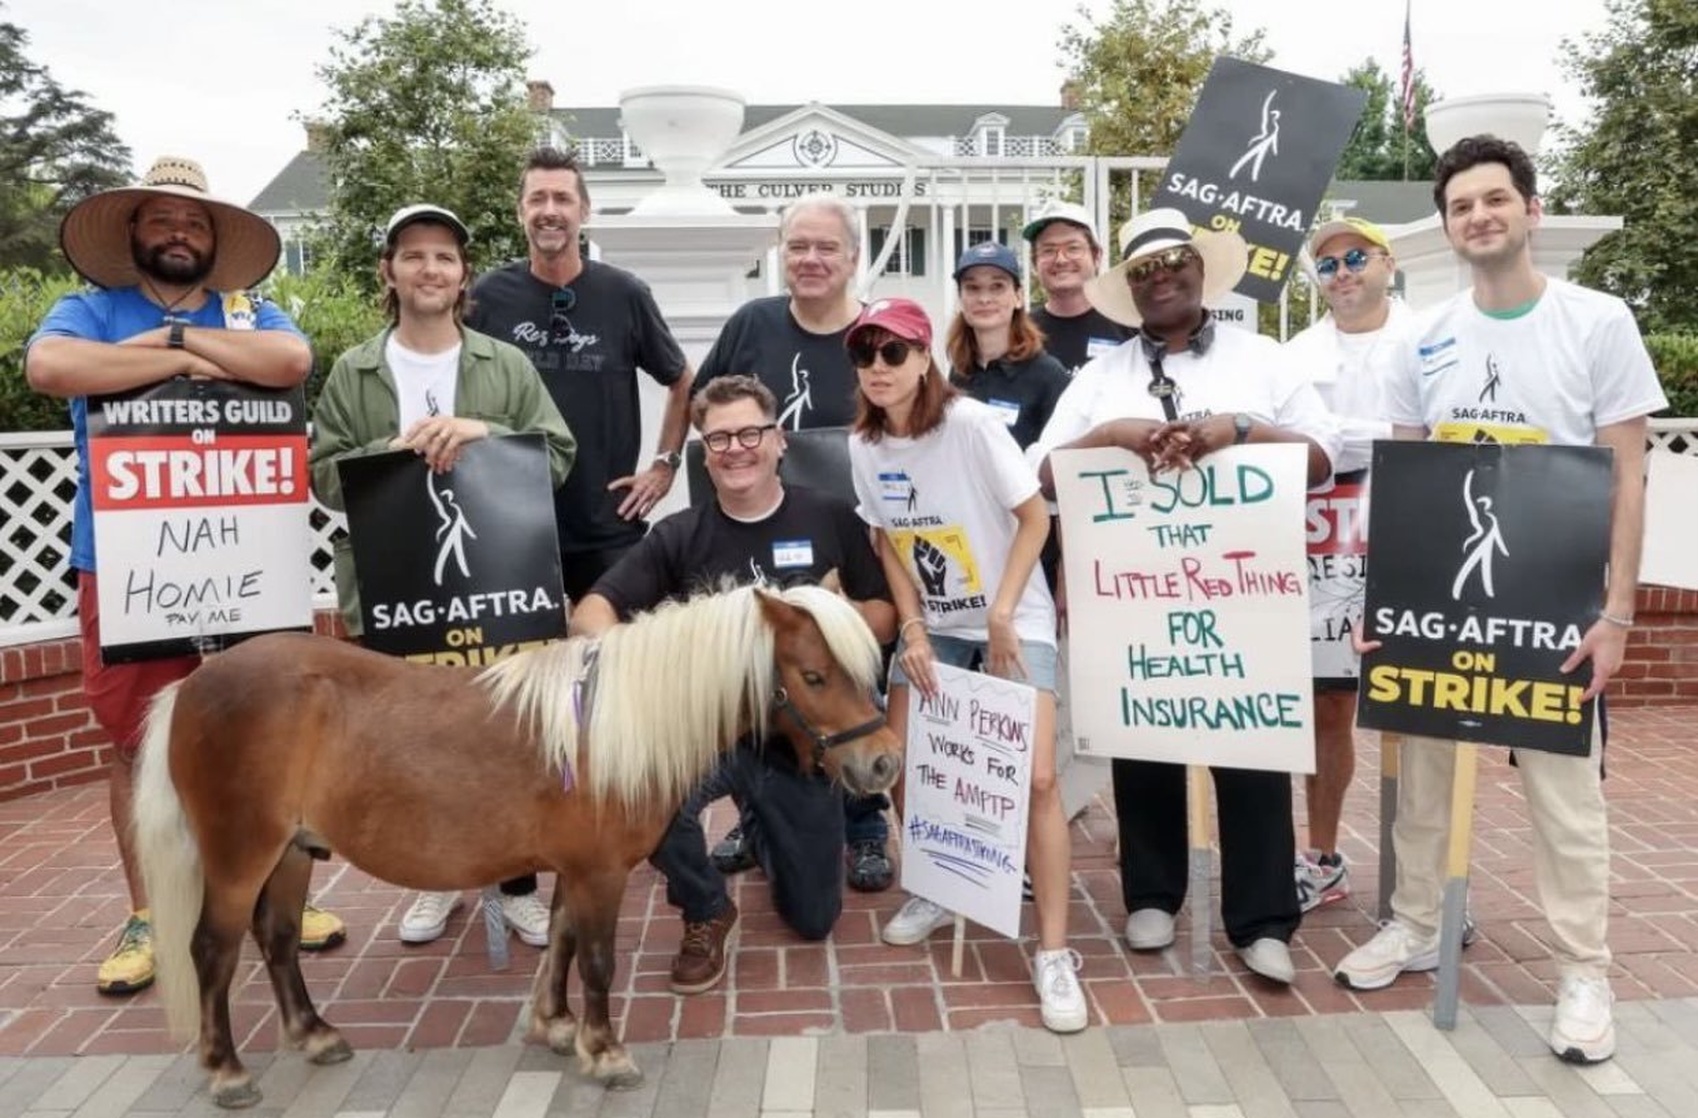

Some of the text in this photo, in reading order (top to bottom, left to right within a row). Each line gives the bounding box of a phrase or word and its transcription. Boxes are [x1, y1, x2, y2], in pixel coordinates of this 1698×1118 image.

[846, 183, 926, 197] STUDIS
[1211, 214, 1242, 235] ON
[102, 400, 292, 424] WRITERS GUILD
[191, 429, 216, 444] ON
[106, 447, 295, 499] STRIKE!
[1079, 470, 1135, 523] I
[1149, 463, 1274, 513] SOLD
[158, 515, 239, 557] NAH
[1147, 524, 1213, 548] THAT
[125, 569, 264, 614] HOMIE
[1094, 551, 1302, 601] LITTLE RED THING
[208, 608, 241, 622] ME
[927, 595, 987, 613] STRIKE!
[446, 627, 483, 646] ON
[1168, 609, 1224, 648] FOR
[1129, 643, 1245, 680] HEALTH
[1452, 651, 1496, 673] ON
[918, 692, 960, 721] ANN
[1121, 688, 1303, 729] INSURANCE
[1368, 665, 1584, 725] STRIKE!
[928, 733, 1018, 786] WORKS FOR
[916, 764, 1015, 821] THE AMPTP
